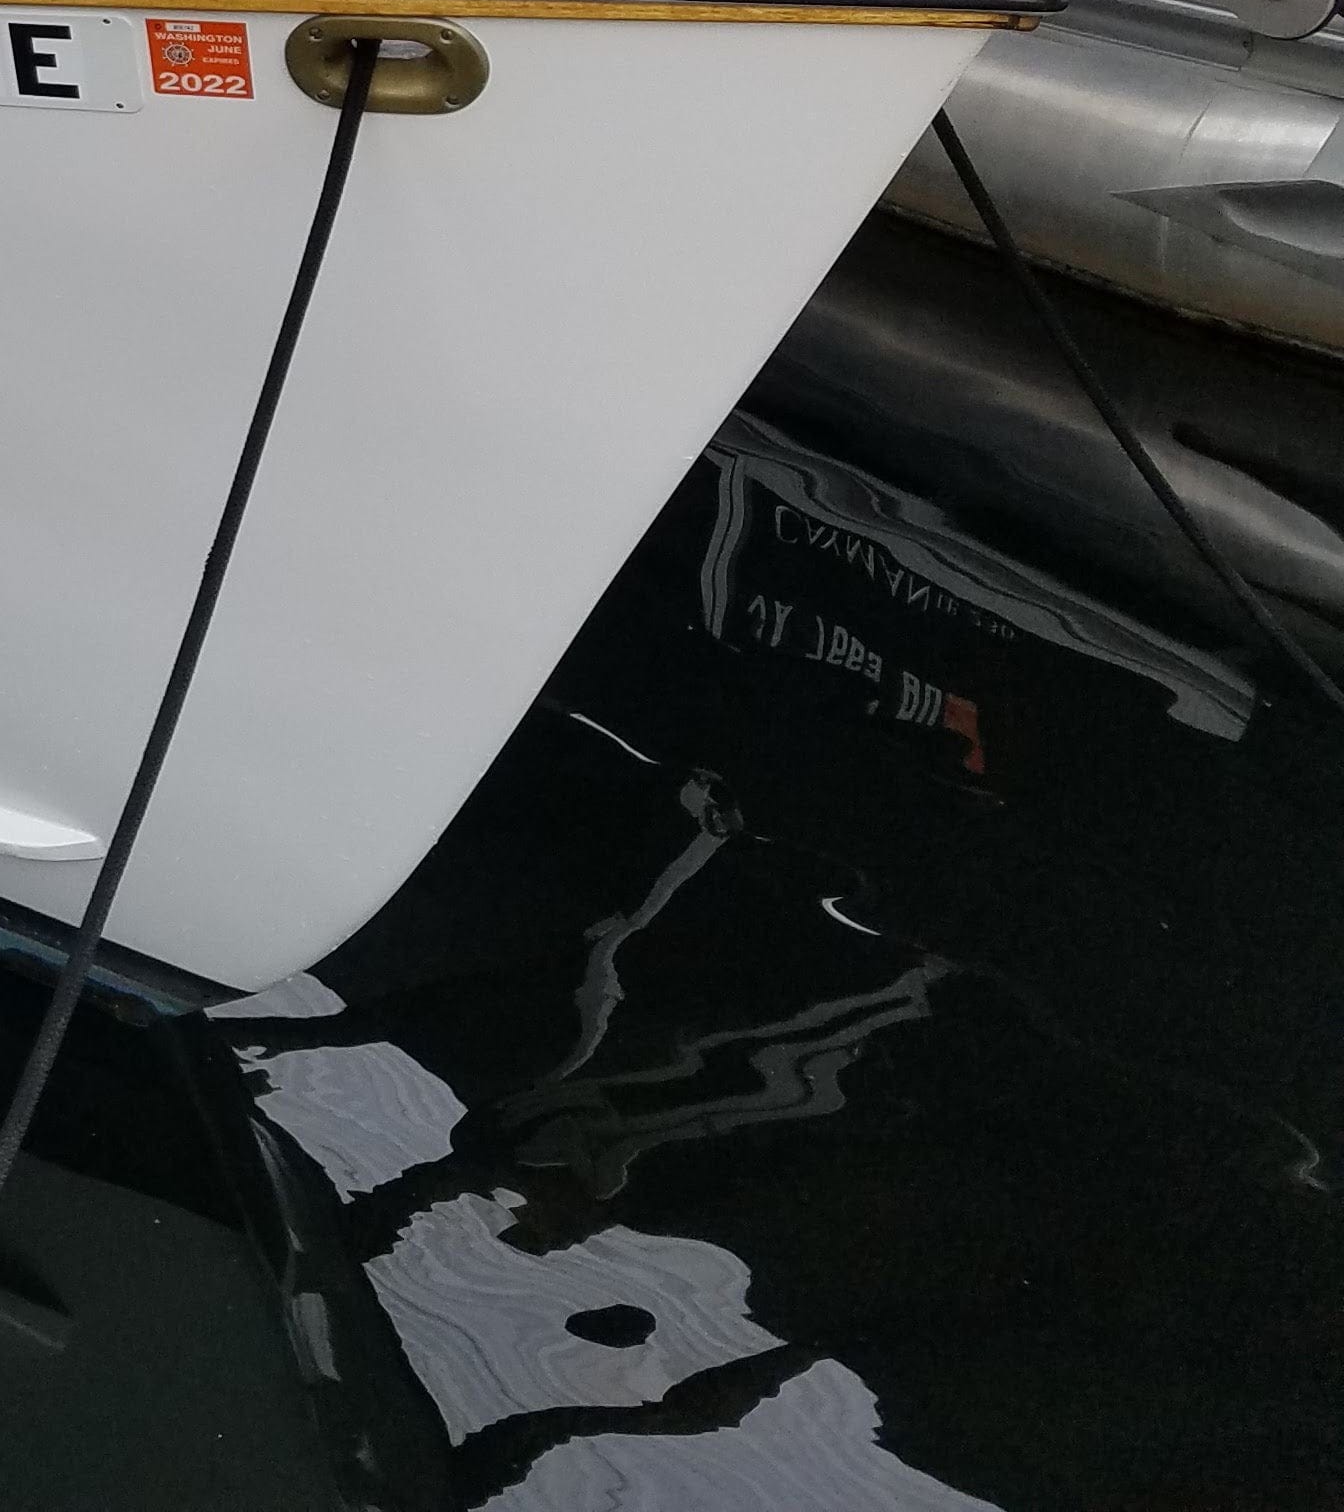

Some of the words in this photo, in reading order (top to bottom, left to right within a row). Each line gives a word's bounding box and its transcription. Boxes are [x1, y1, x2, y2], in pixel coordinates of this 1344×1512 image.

[154, 32, 243, 44] WASHINGTON
[207, 45, 242, 55] JUNE
[158, 71, 248, 95] 2022
